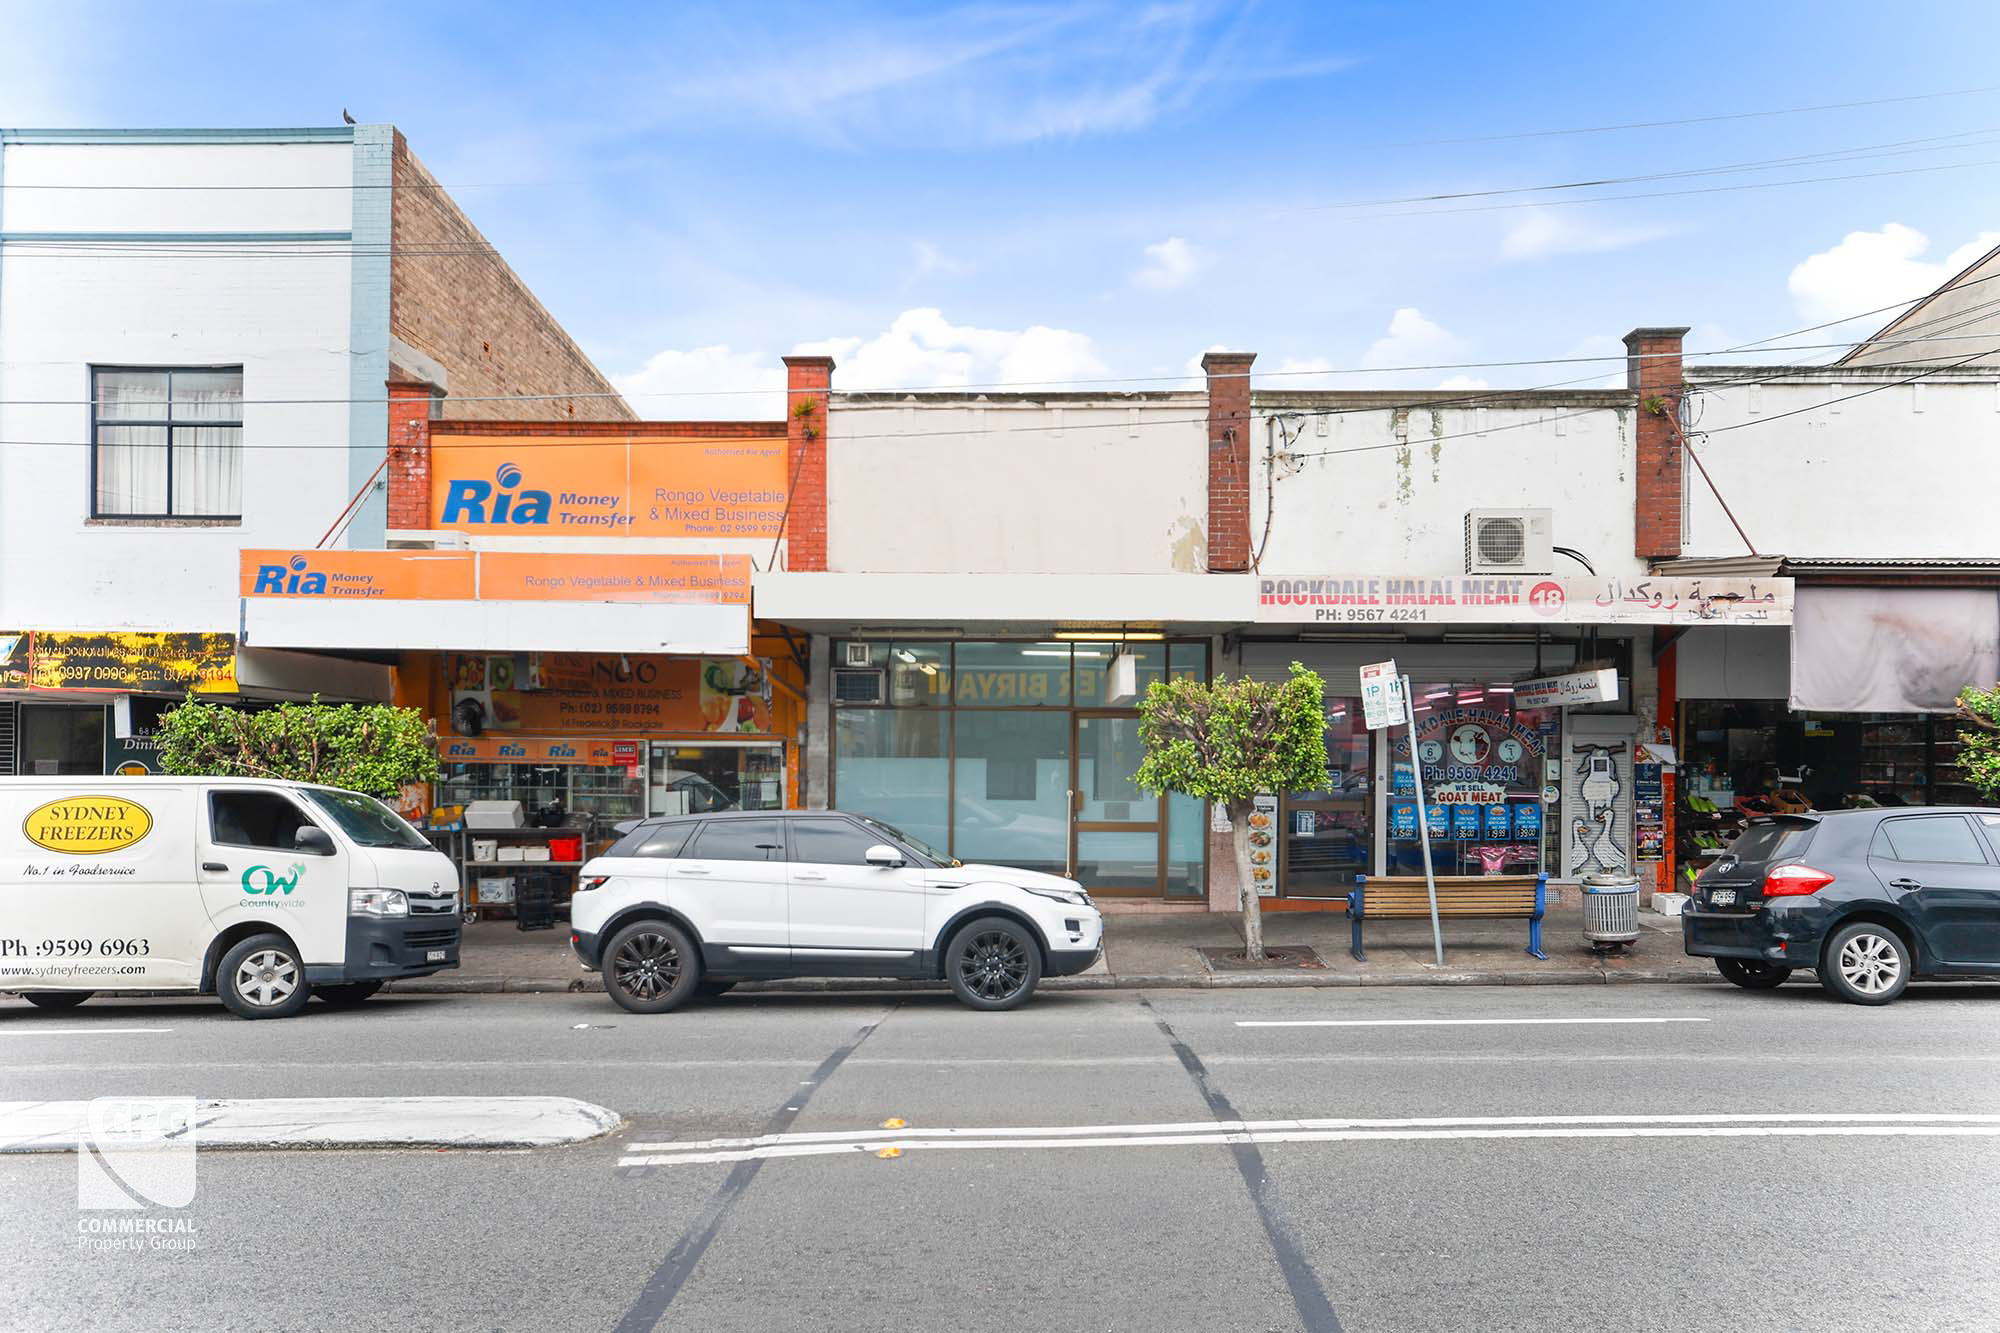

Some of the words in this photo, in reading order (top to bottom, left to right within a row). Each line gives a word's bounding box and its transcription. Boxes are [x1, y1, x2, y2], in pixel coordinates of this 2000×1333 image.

[441, 462, 552, 525] Ria
[559, 493, 620, 509] Money
[655, 488, 705, 505] Rongo
[709, 488, 785, 505] Vegetable
[559, 512, 637, 529] Transfer
[649, 507, 660, 521] &
[665, 507, 710, 521] Mixed
[715, 507, 785, 521] Business
[720, 524, 731, 533] 02
[735, 524, 759, 533] 9599
[253, 554, 328, 595] Ria
[331, 573, 374, 584] Money
[525, 575, 565, 588] Rongo
[569, 575, 631, 588] Vegetable
[635, 576, 644, 587] &
[648, 576, 686, 587] Mixed
[690, 576, 745, 588] Business
[331, 586, 385, 597] Transfer
[1260, 579, 1380, 605] ROCKDALE
[1386, 579, 1457, 605] HALAL
[1462, 579, 1523, 605] MEAT
[1534, 589, 1563, 609] 18
[1315, 609, 1342, 621] PH:
[1347, 609, 1384, 621] 9567
[1390, 609, 1427, 621] 4241
[1366, 685, 1380, 698] 1P
[1511, 722, 1546, 758] MEAT
[448, 741, 476, 756] Ria
[498, 742, 526, 757] Ria
[548, 742, 576, 758] Ria
[1427, 747, 1434, 757] 6
[1423, 765, 1445, 780] Ph:
[1448, 765, 1481, 780] 9567
[1484, 765, 1518, 781] 4241
[1455, 784, 1467, 792] WE
[1467, 784, 1485, 792] SELL
[1438, 791, 1468, 803] GOAT
[1471, 791, 1503, 803] MEAT
[49, 806, 131, 821] SYDNEY
[38, 825, 135, 841] FREEZERS
[23, 864, 50, 876] No.1
[53, 866, 66, 876] in
[68, 863, 136, 876] Foodservice
[239, 898, 305, 909] Countrywide
[0, 938, 28, 957] Ph
[99, 938, 150, 957] 6963
[0, 963, 146, 978] www.sydneyfreezers.com
